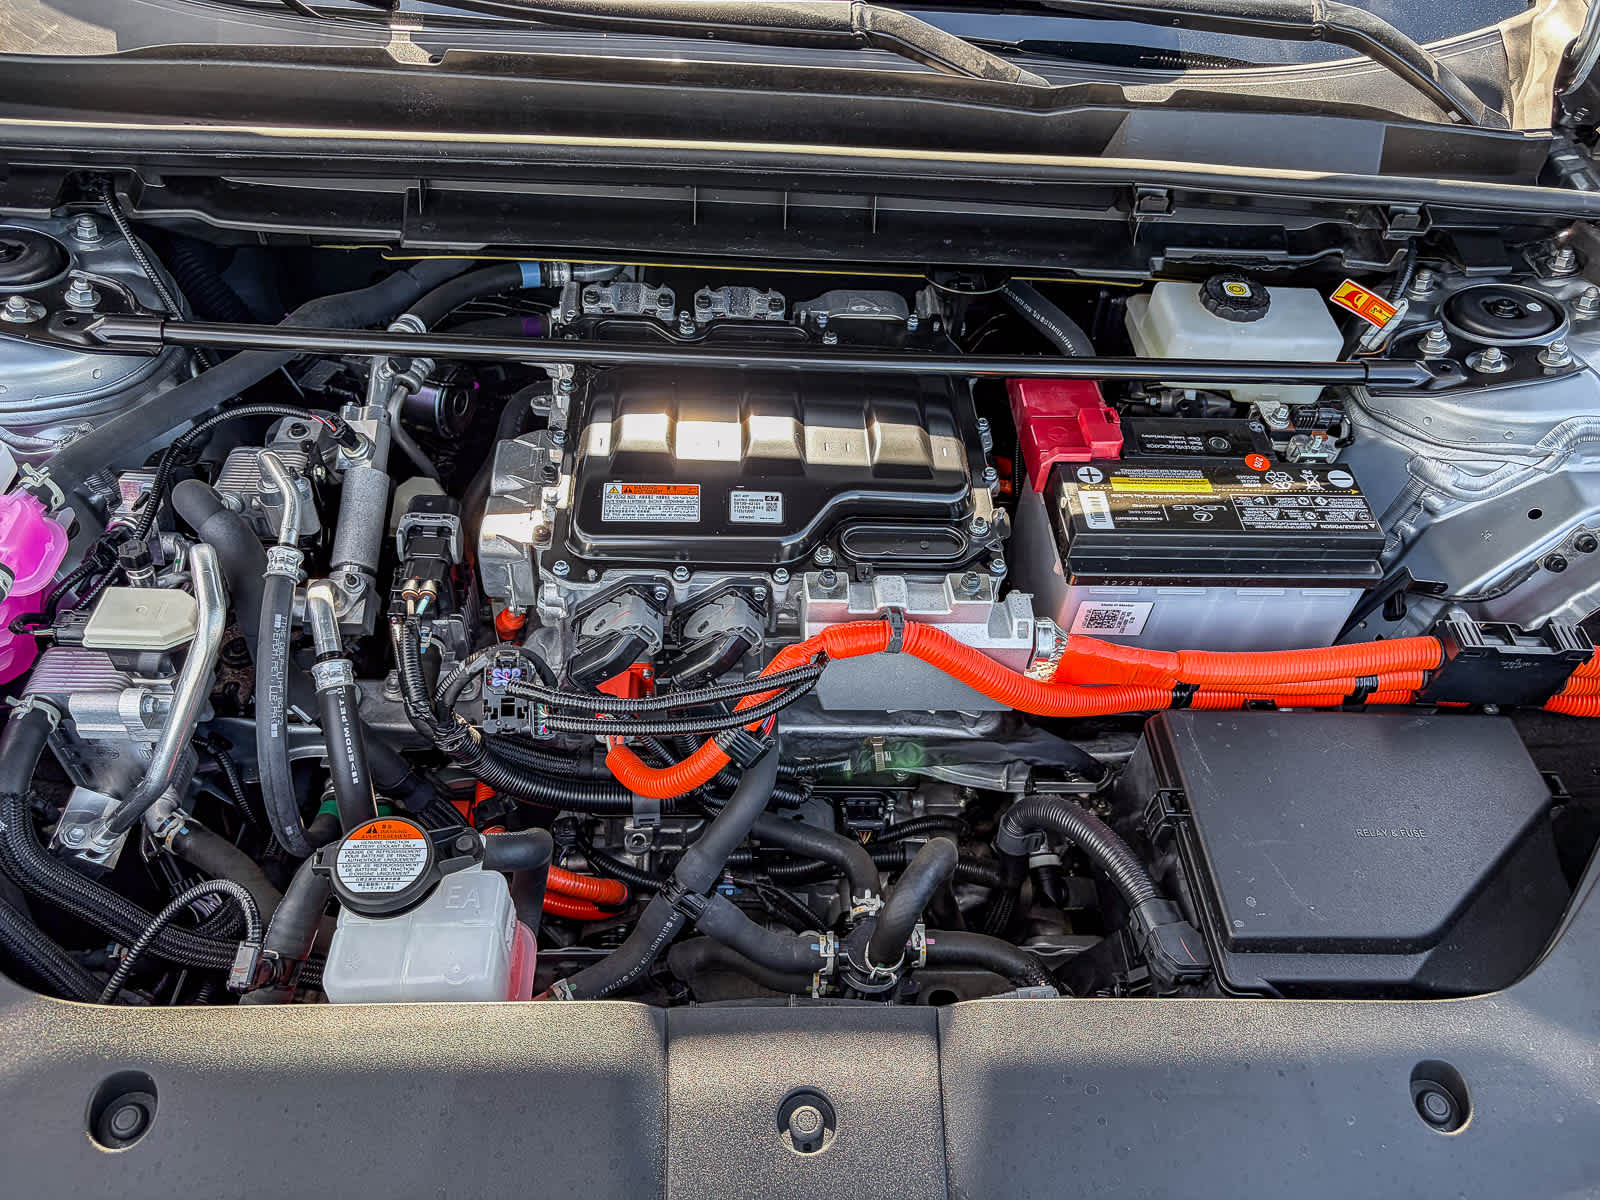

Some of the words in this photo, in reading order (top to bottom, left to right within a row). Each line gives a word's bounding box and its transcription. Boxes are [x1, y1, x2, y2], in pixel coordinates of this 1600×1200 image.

[1356, 828, 1388, 838] RELAY
[1390, 830, 1398, 838] &
[1400, 830, 1427, 838] FUSE
